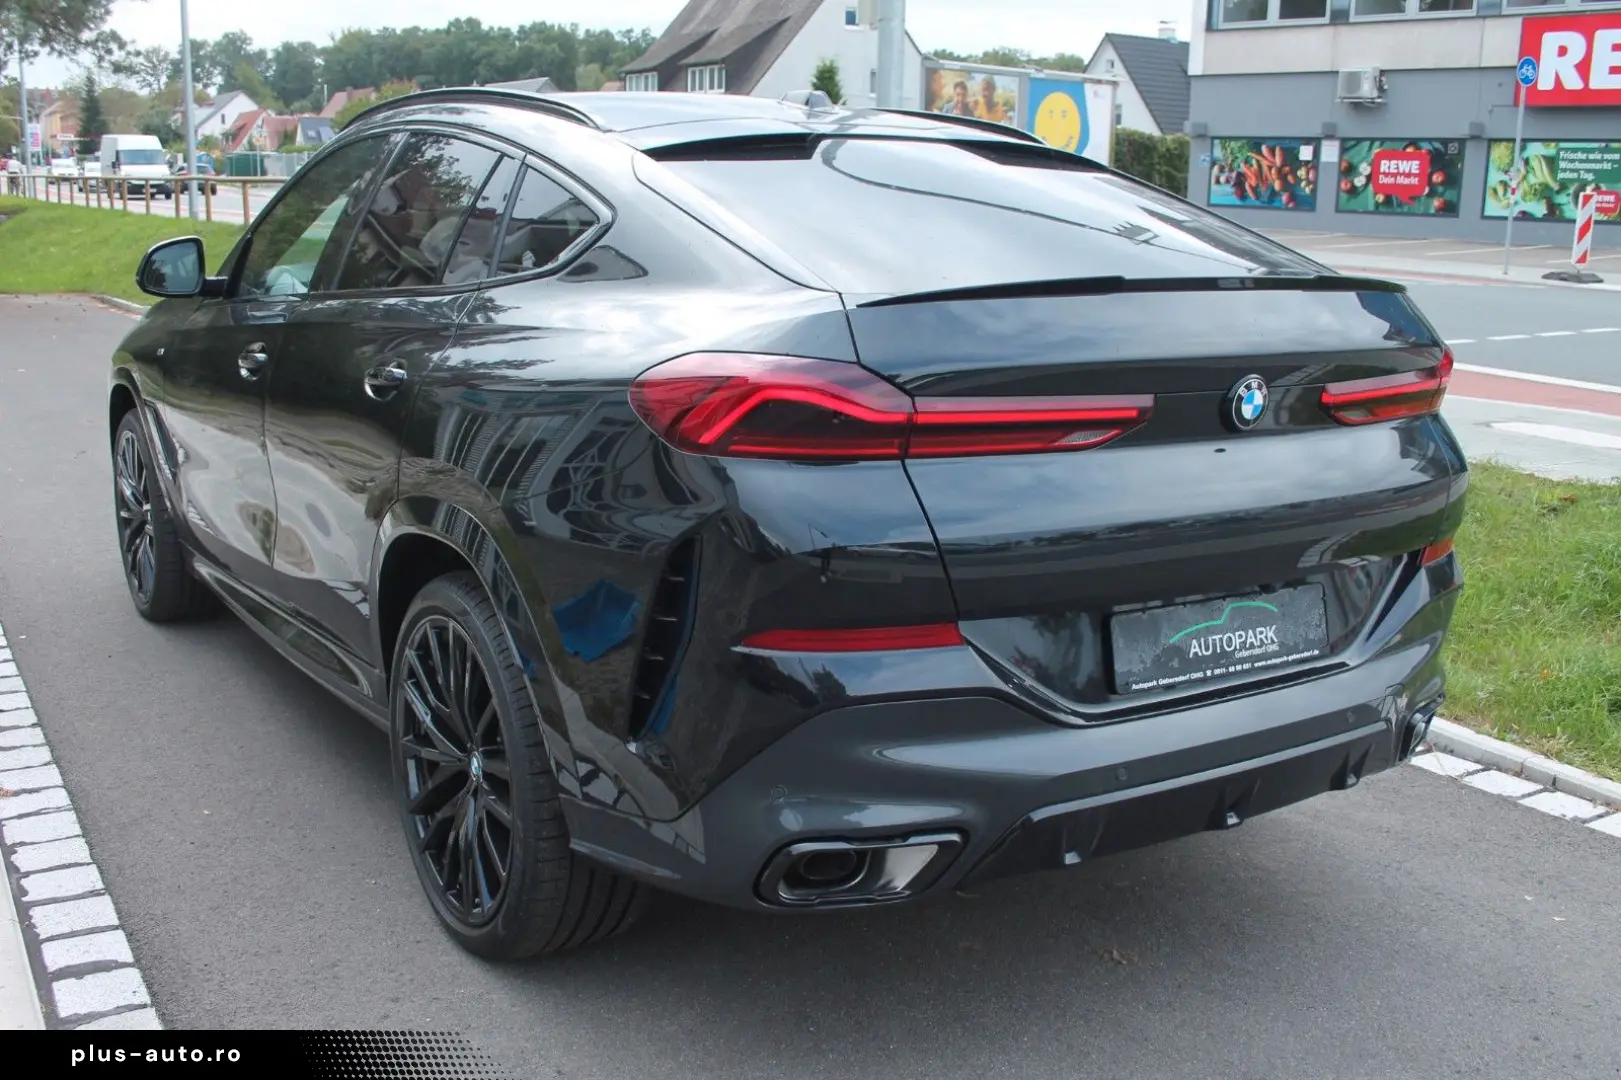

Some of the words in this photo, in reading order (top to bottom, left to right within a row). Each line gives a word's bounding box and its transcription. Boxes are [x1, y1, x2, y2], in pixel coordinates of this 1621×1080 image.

[1560, 150, 1587, 160] Frische
[1588, 151, 1602, 160] wie
[1603, 152, 1620, 160] vom
[1380, 159, 1420, 174] REWE
[1559, 160, 1612, 170] Wochenmarkt
[1378, 174, 1395, 184] Dein
[1396, 174, 1419, 185] Markt
[1557, 169, 1578, 181] jeden
[1580, 170, 1596, 181] Tag.
[1239, 381, 1267, 397] BMW
[1189, 625, 1278, 658] AUTOPARK
[1235, 645, 1265, 658] Gebersdorf
[1266, 643, 1280, 653] OHG
[1132, 679, 1157, 690] Autopark
[1158, 673, 1190, 685] Gebersdorf
[1190, 671, 1204, 680] OHG
